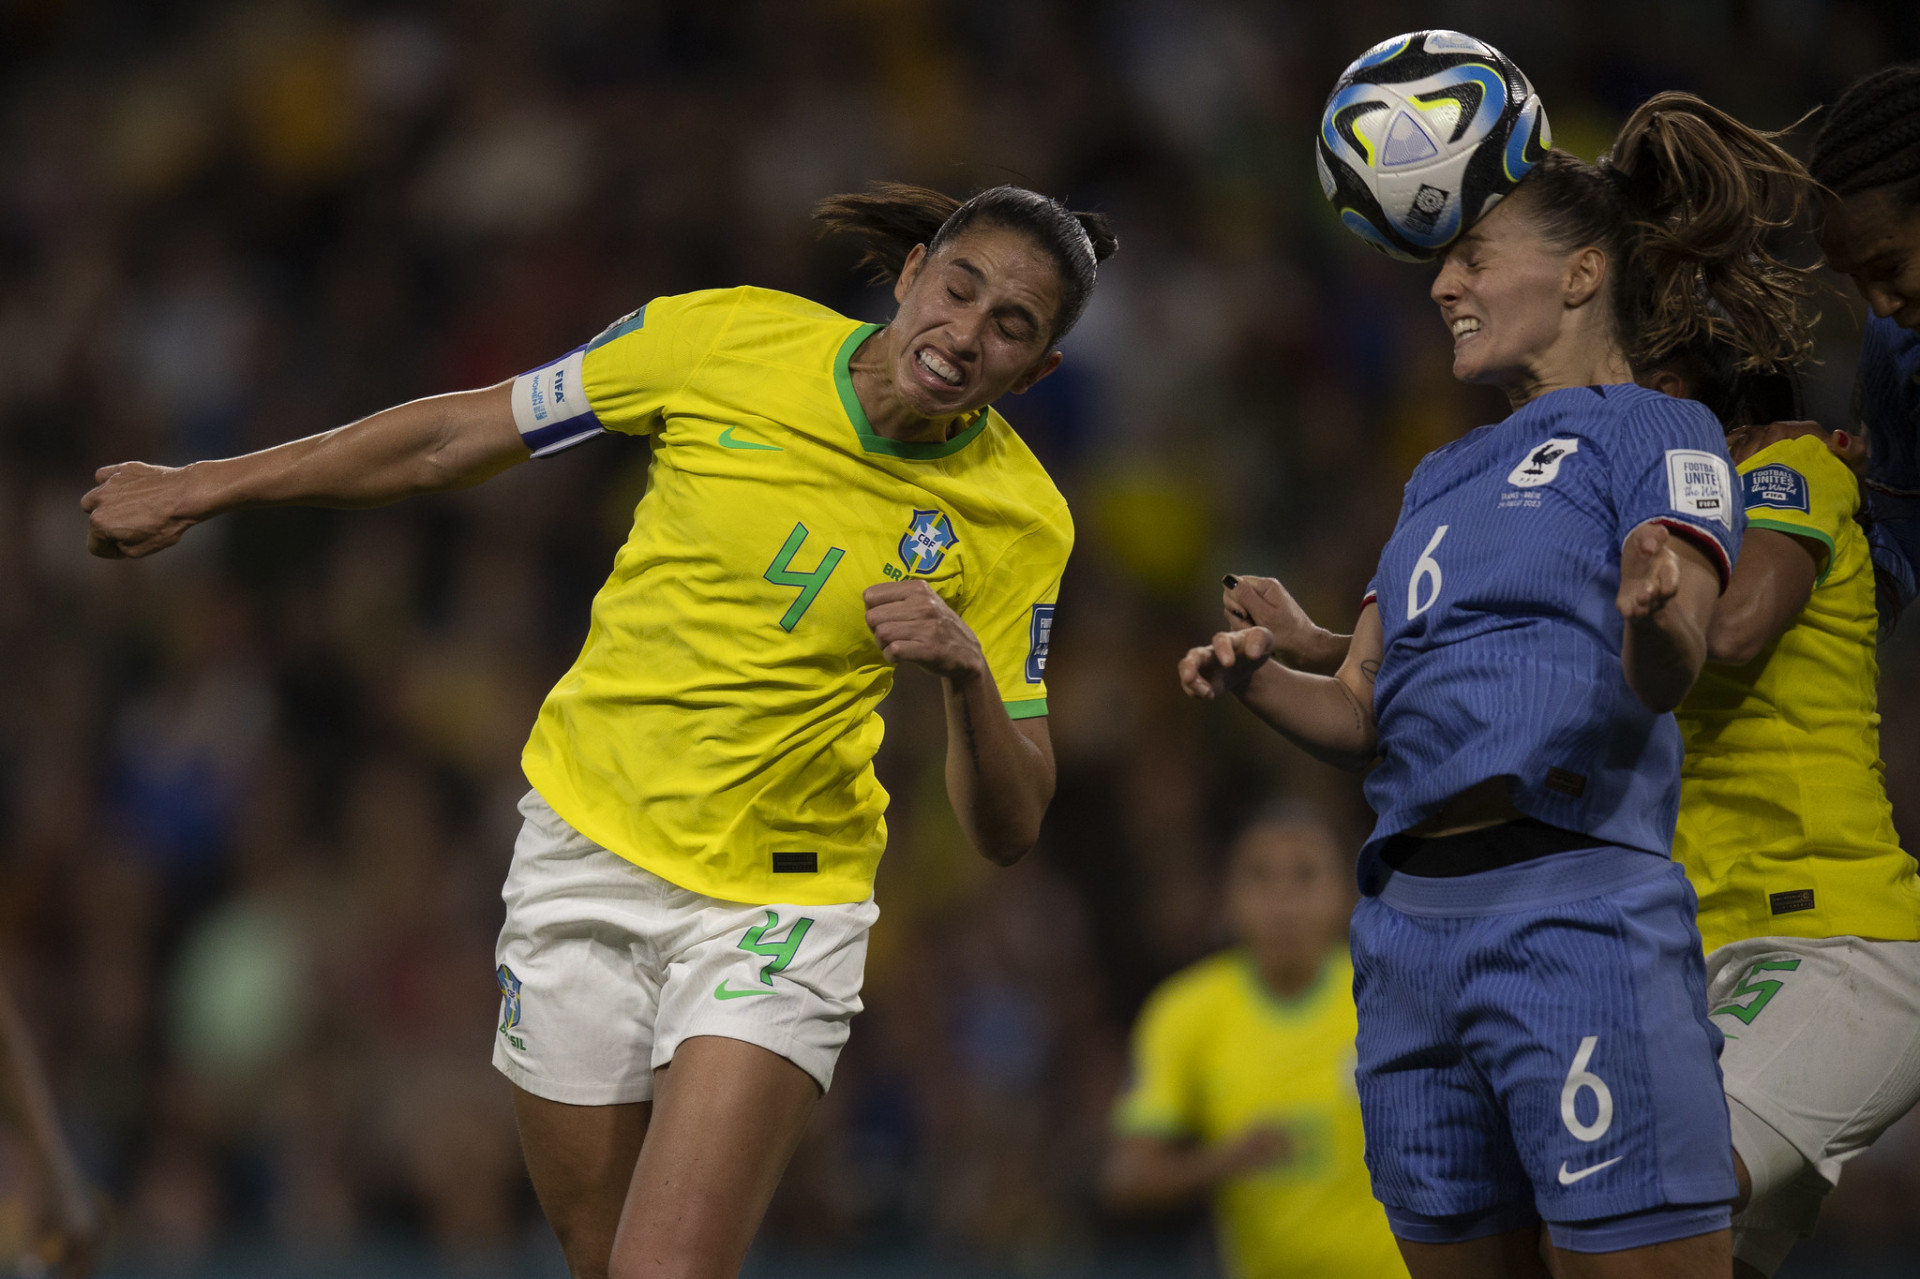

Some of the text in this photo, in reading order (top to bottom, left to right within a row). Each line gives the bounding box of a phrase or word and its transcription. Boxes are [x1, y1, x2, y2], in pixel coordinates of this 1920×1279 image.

[555, 370, 563, 403] FIFA
[1684, 461, 1715, 473] FOOTBA
[1685, 472, 1717, 486] UNITE
[1698, 500, 1717, 508] FIFA
[917, 533, 936, 549] CBF
[763, 521, 846, 633] 4
[1407, 525, 1449, 620] 6
[737, 911, 815, 986] 4
[1708, 959, 1802, 1025] 5
[1560, 1035, 1613, 1142] 6
